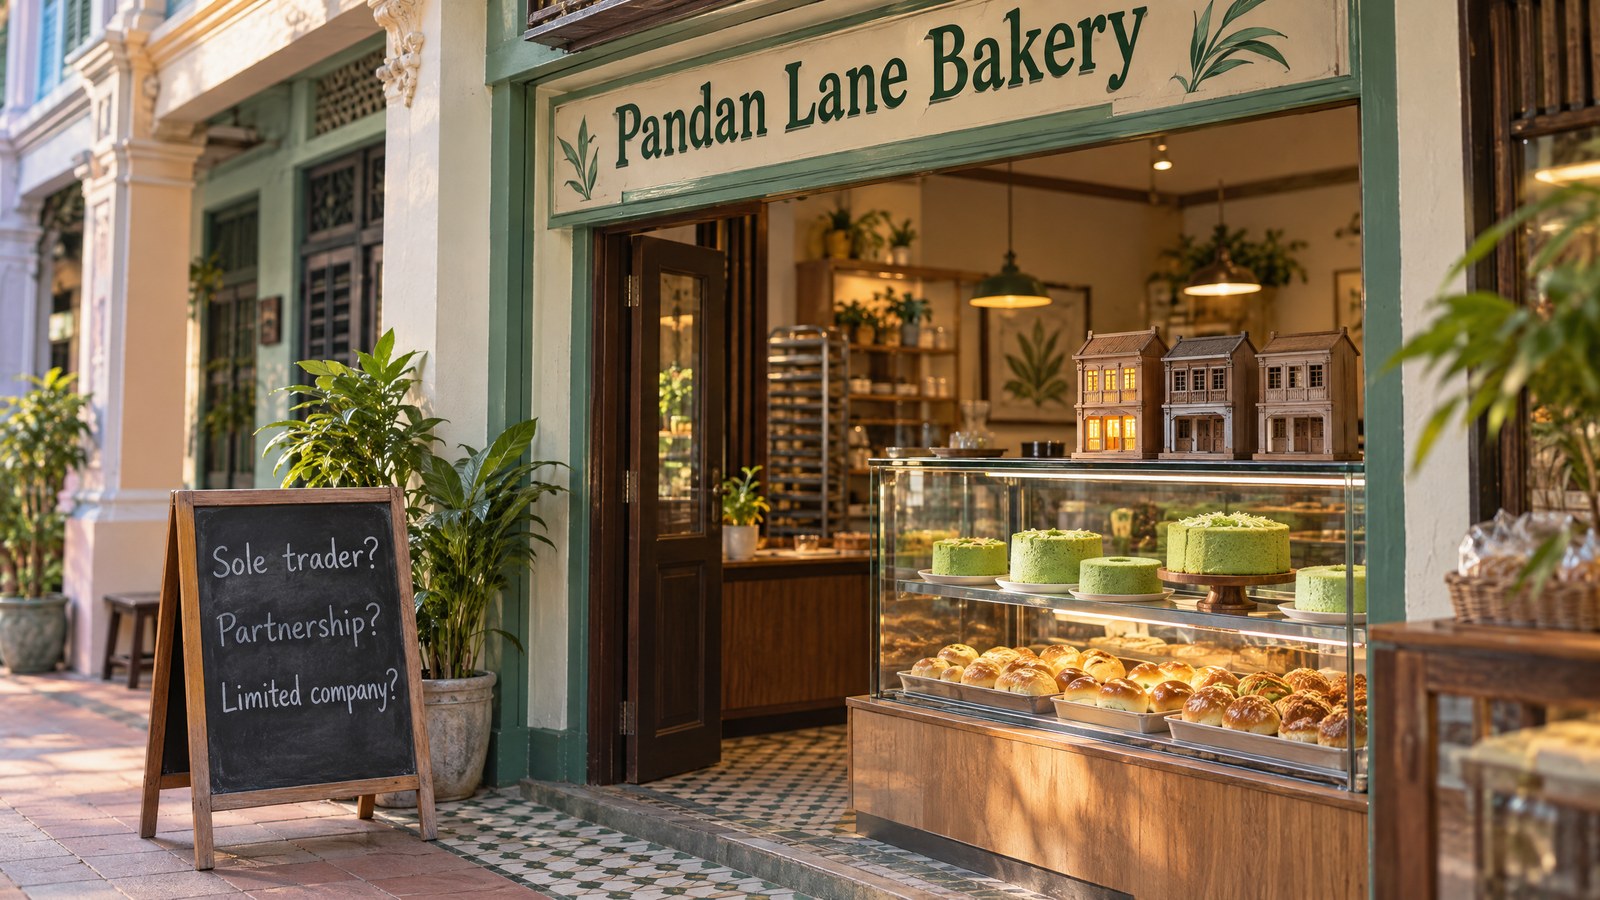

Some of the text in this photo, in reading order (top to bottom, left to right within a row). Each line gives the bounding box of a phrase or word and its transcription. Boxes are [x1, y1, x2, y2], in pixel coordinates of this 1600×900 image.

[615, 6, 1148, 168] Pandan Lane Bakery
[212, 536, 379, 578] Sole trader?
[216, 602, 381, 647] Partnership?
[222, 667, 398, 714] Limited company?
